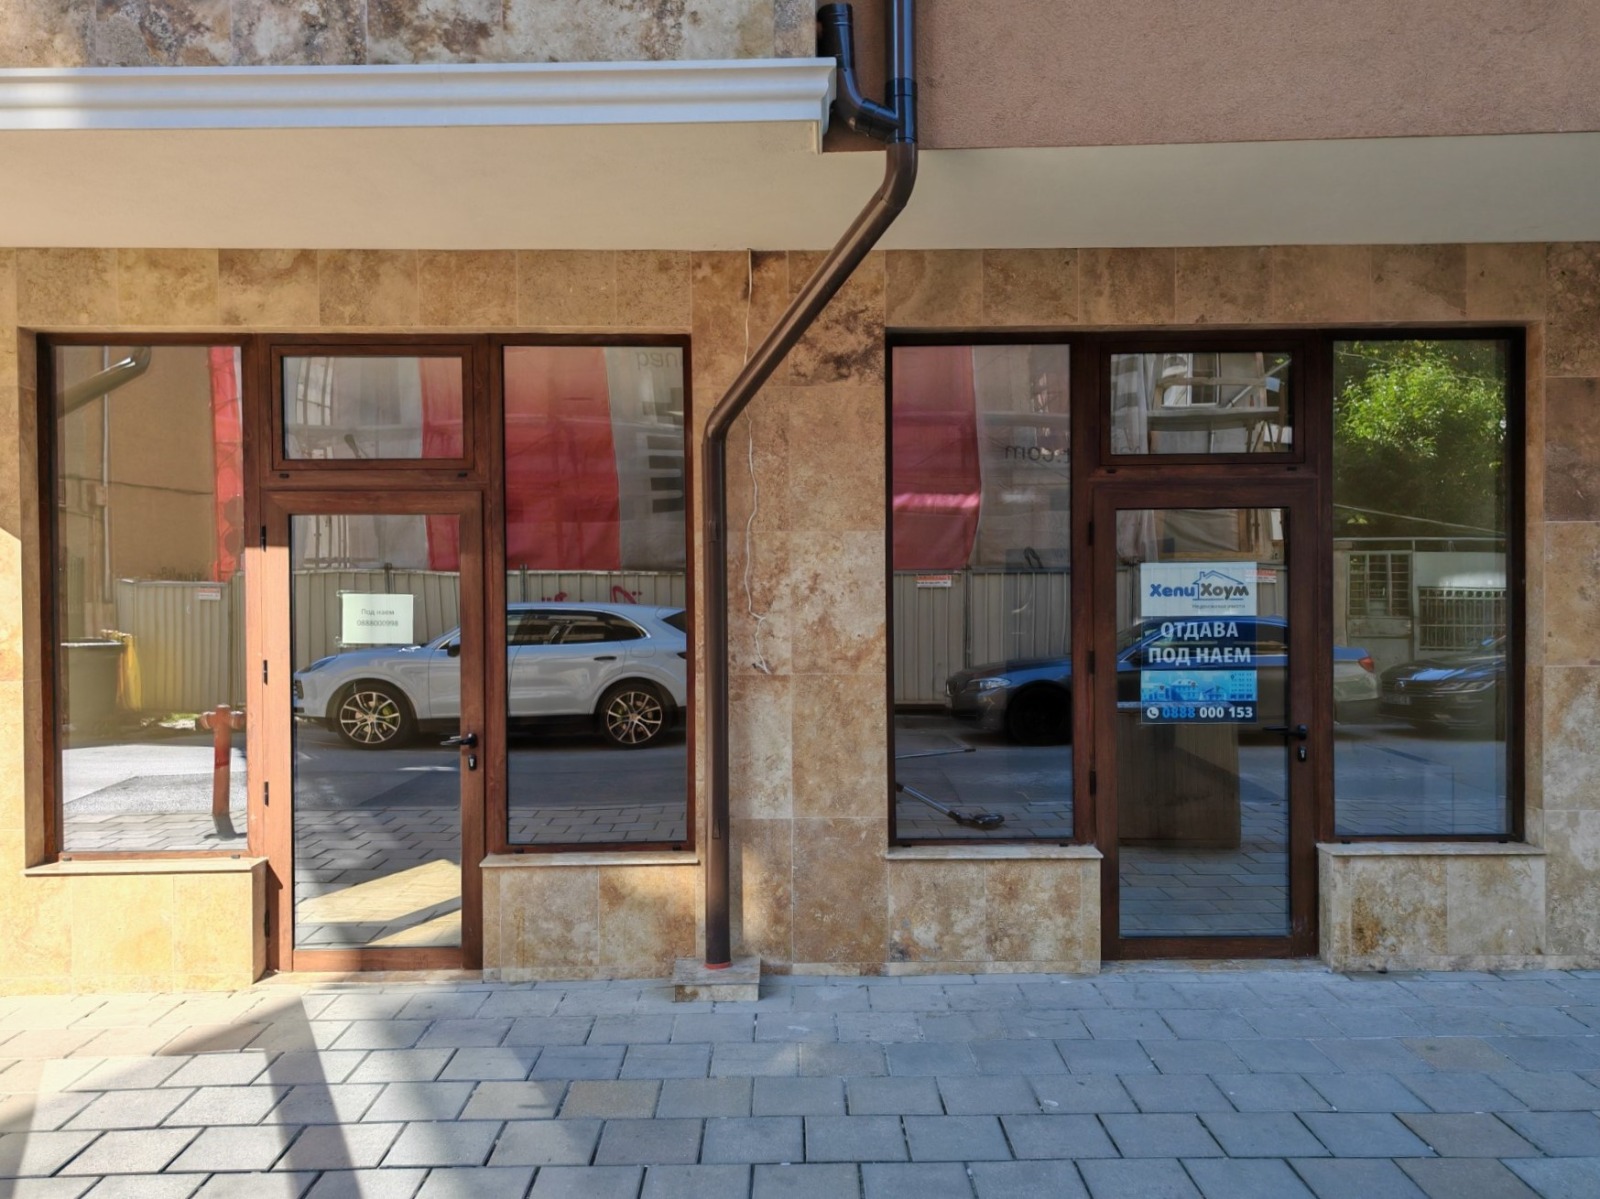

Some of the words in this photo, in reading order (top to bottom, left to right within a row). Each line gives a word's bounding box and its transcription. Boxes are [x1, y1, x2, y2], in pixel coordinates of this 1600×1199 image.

[1201, 583, 1249, 600] Хоум
[1160, 621, 1239, 640] ОТДАВА
[1148, 647, 1191, 666] ПОД
[1196, 647, 1251, 663] НАЕМ
[1162, 706, 1195, 718] 0888
[1199, 706, 1224, 718] 000
[1228, 706, 1253, 718] 153
